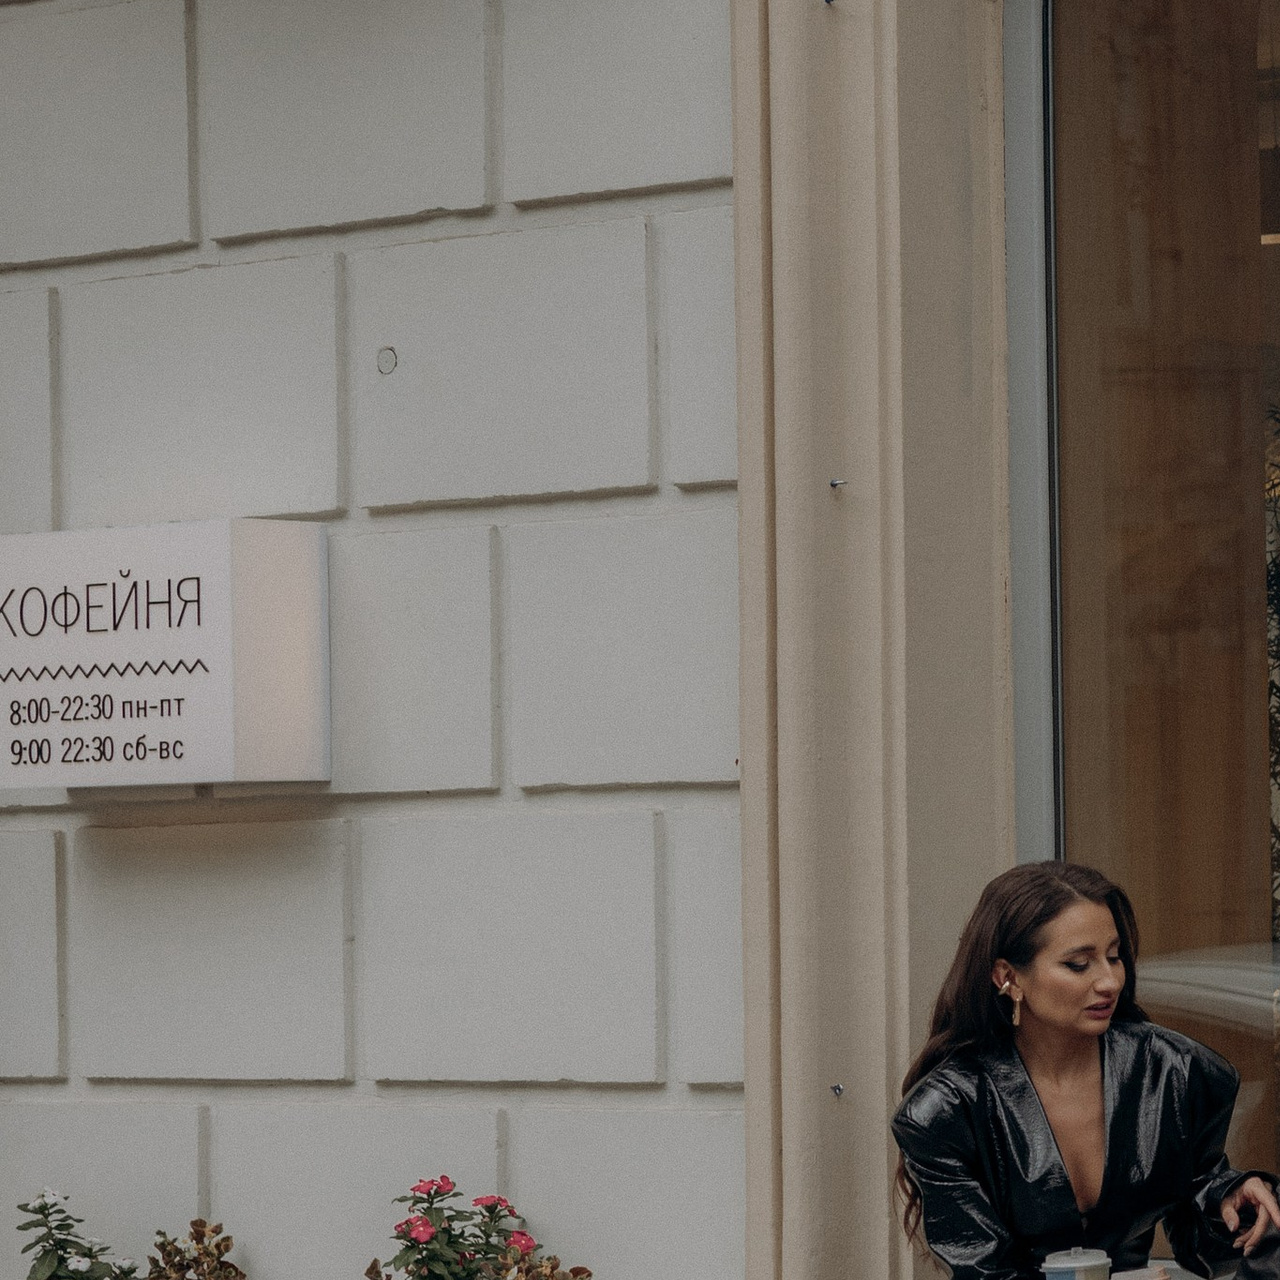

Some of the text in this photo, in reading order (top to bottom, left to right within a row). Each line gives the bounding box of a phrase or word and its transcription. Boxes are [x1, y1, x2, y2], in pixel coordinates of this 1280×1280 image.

[0, 568, 201, 638] КОФЕЙНЯ
[9, 693, 185, 726] 8:00-22:30 пн-пт
[10, 733, 184, 766] 9:00 22:30 сб-вс
